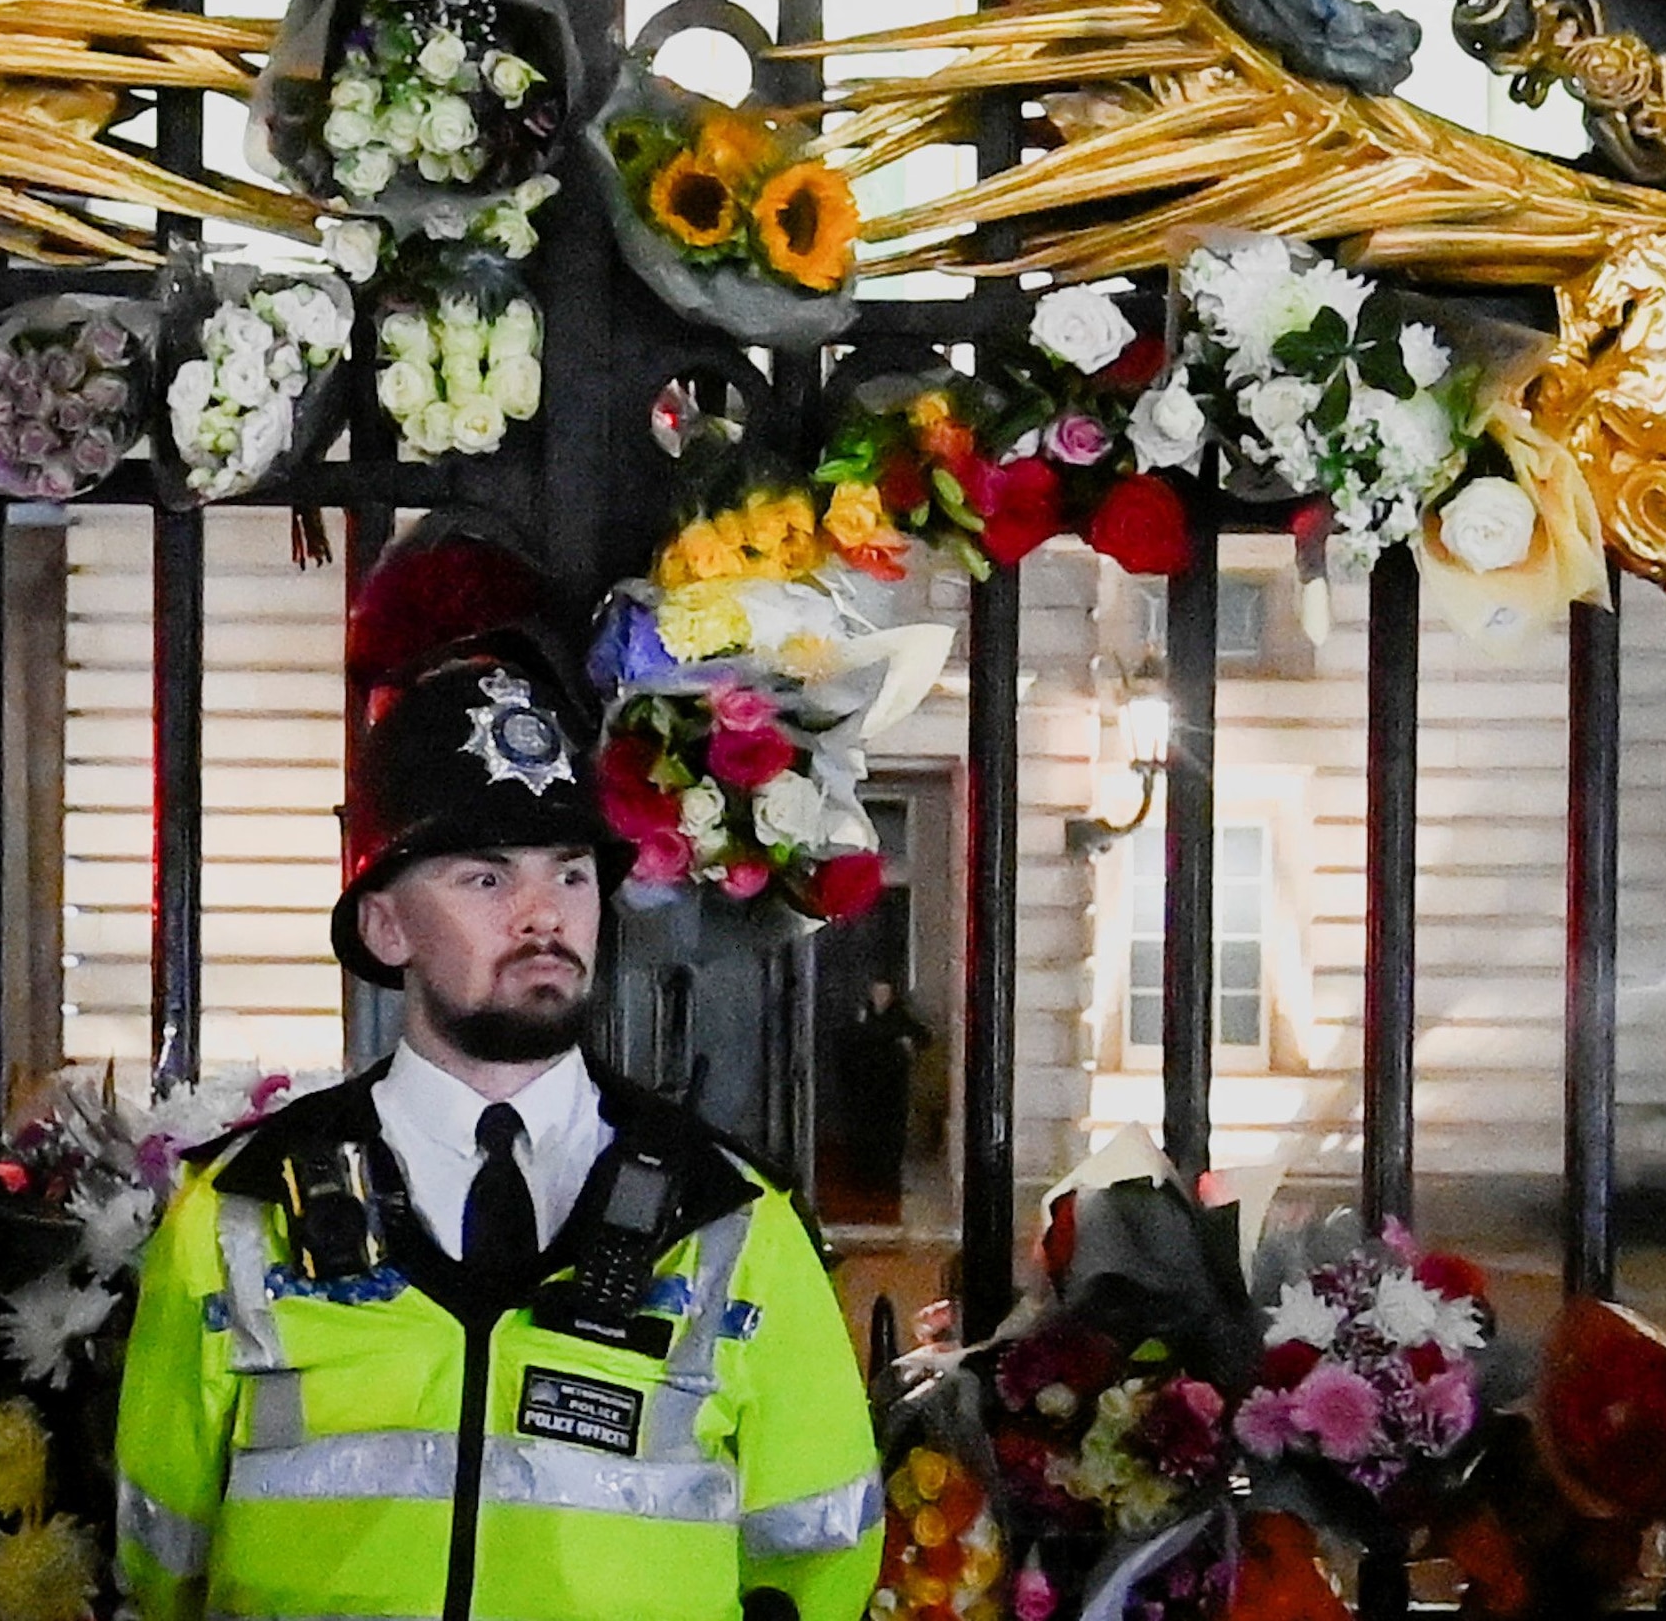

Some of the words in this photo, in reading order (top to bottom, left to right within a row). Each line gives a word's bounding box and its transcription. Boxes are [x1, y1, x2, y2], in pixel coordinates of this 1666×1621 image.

[569, 1399, 620, 1421] POLICE
[524, 1410, 575, 1434] POLICE
[576, 1421, 630, 1449] OFFICER
